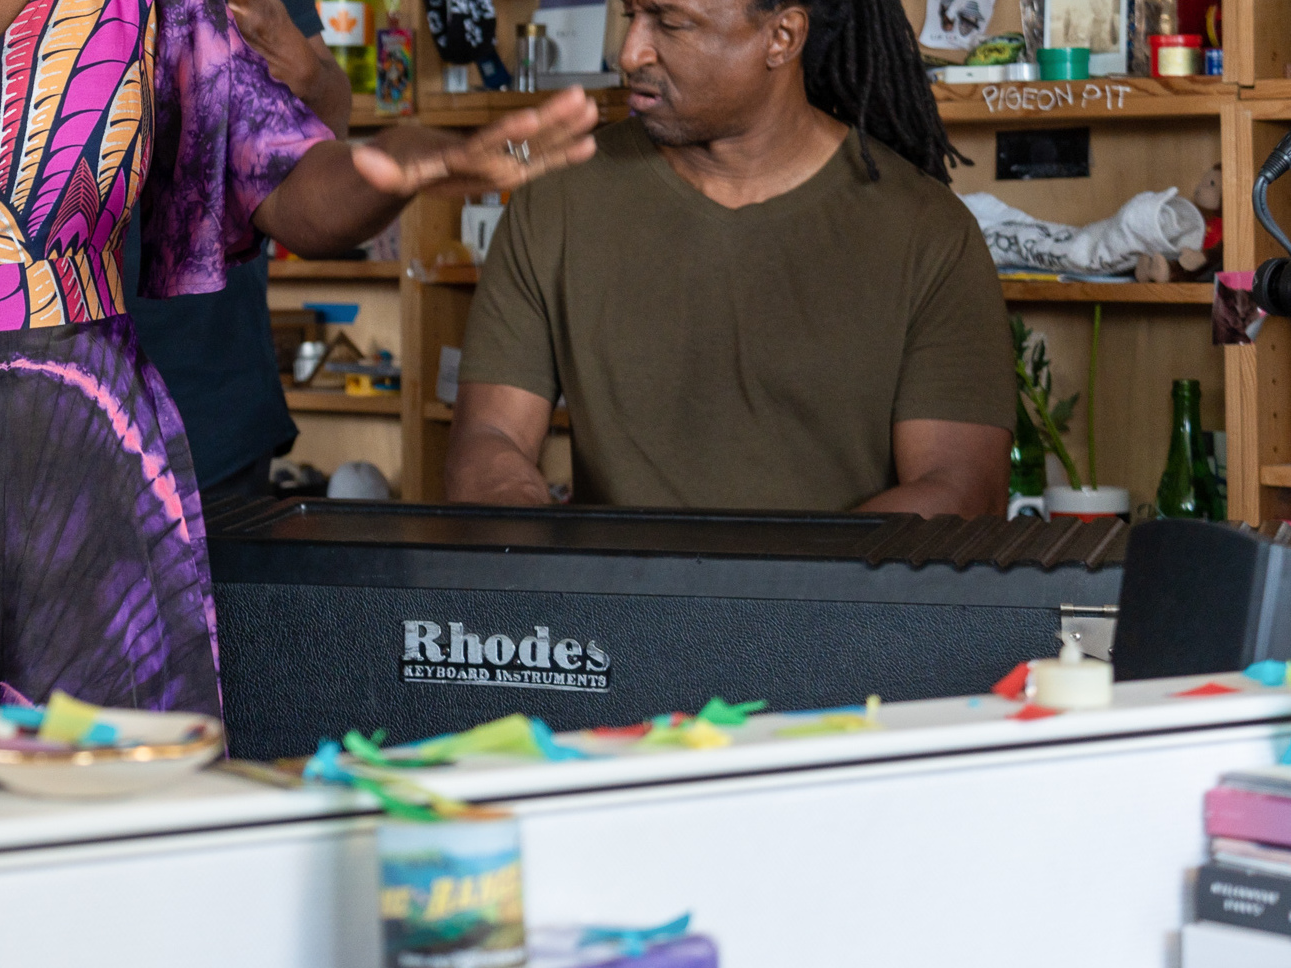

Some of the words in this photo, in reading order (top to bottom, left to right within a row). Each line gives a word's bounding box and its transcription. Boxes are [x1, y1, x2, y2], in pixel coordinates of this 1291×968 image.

[982, 83, 1074, 113] PIGEON
[1081, 84, 1131, 111] PIT
[401, 620, 610, 672] Rhodes
[404, 665, 490, 682] KEYBOARD
[495, 669, 607, 688] INSTRUMENTS
